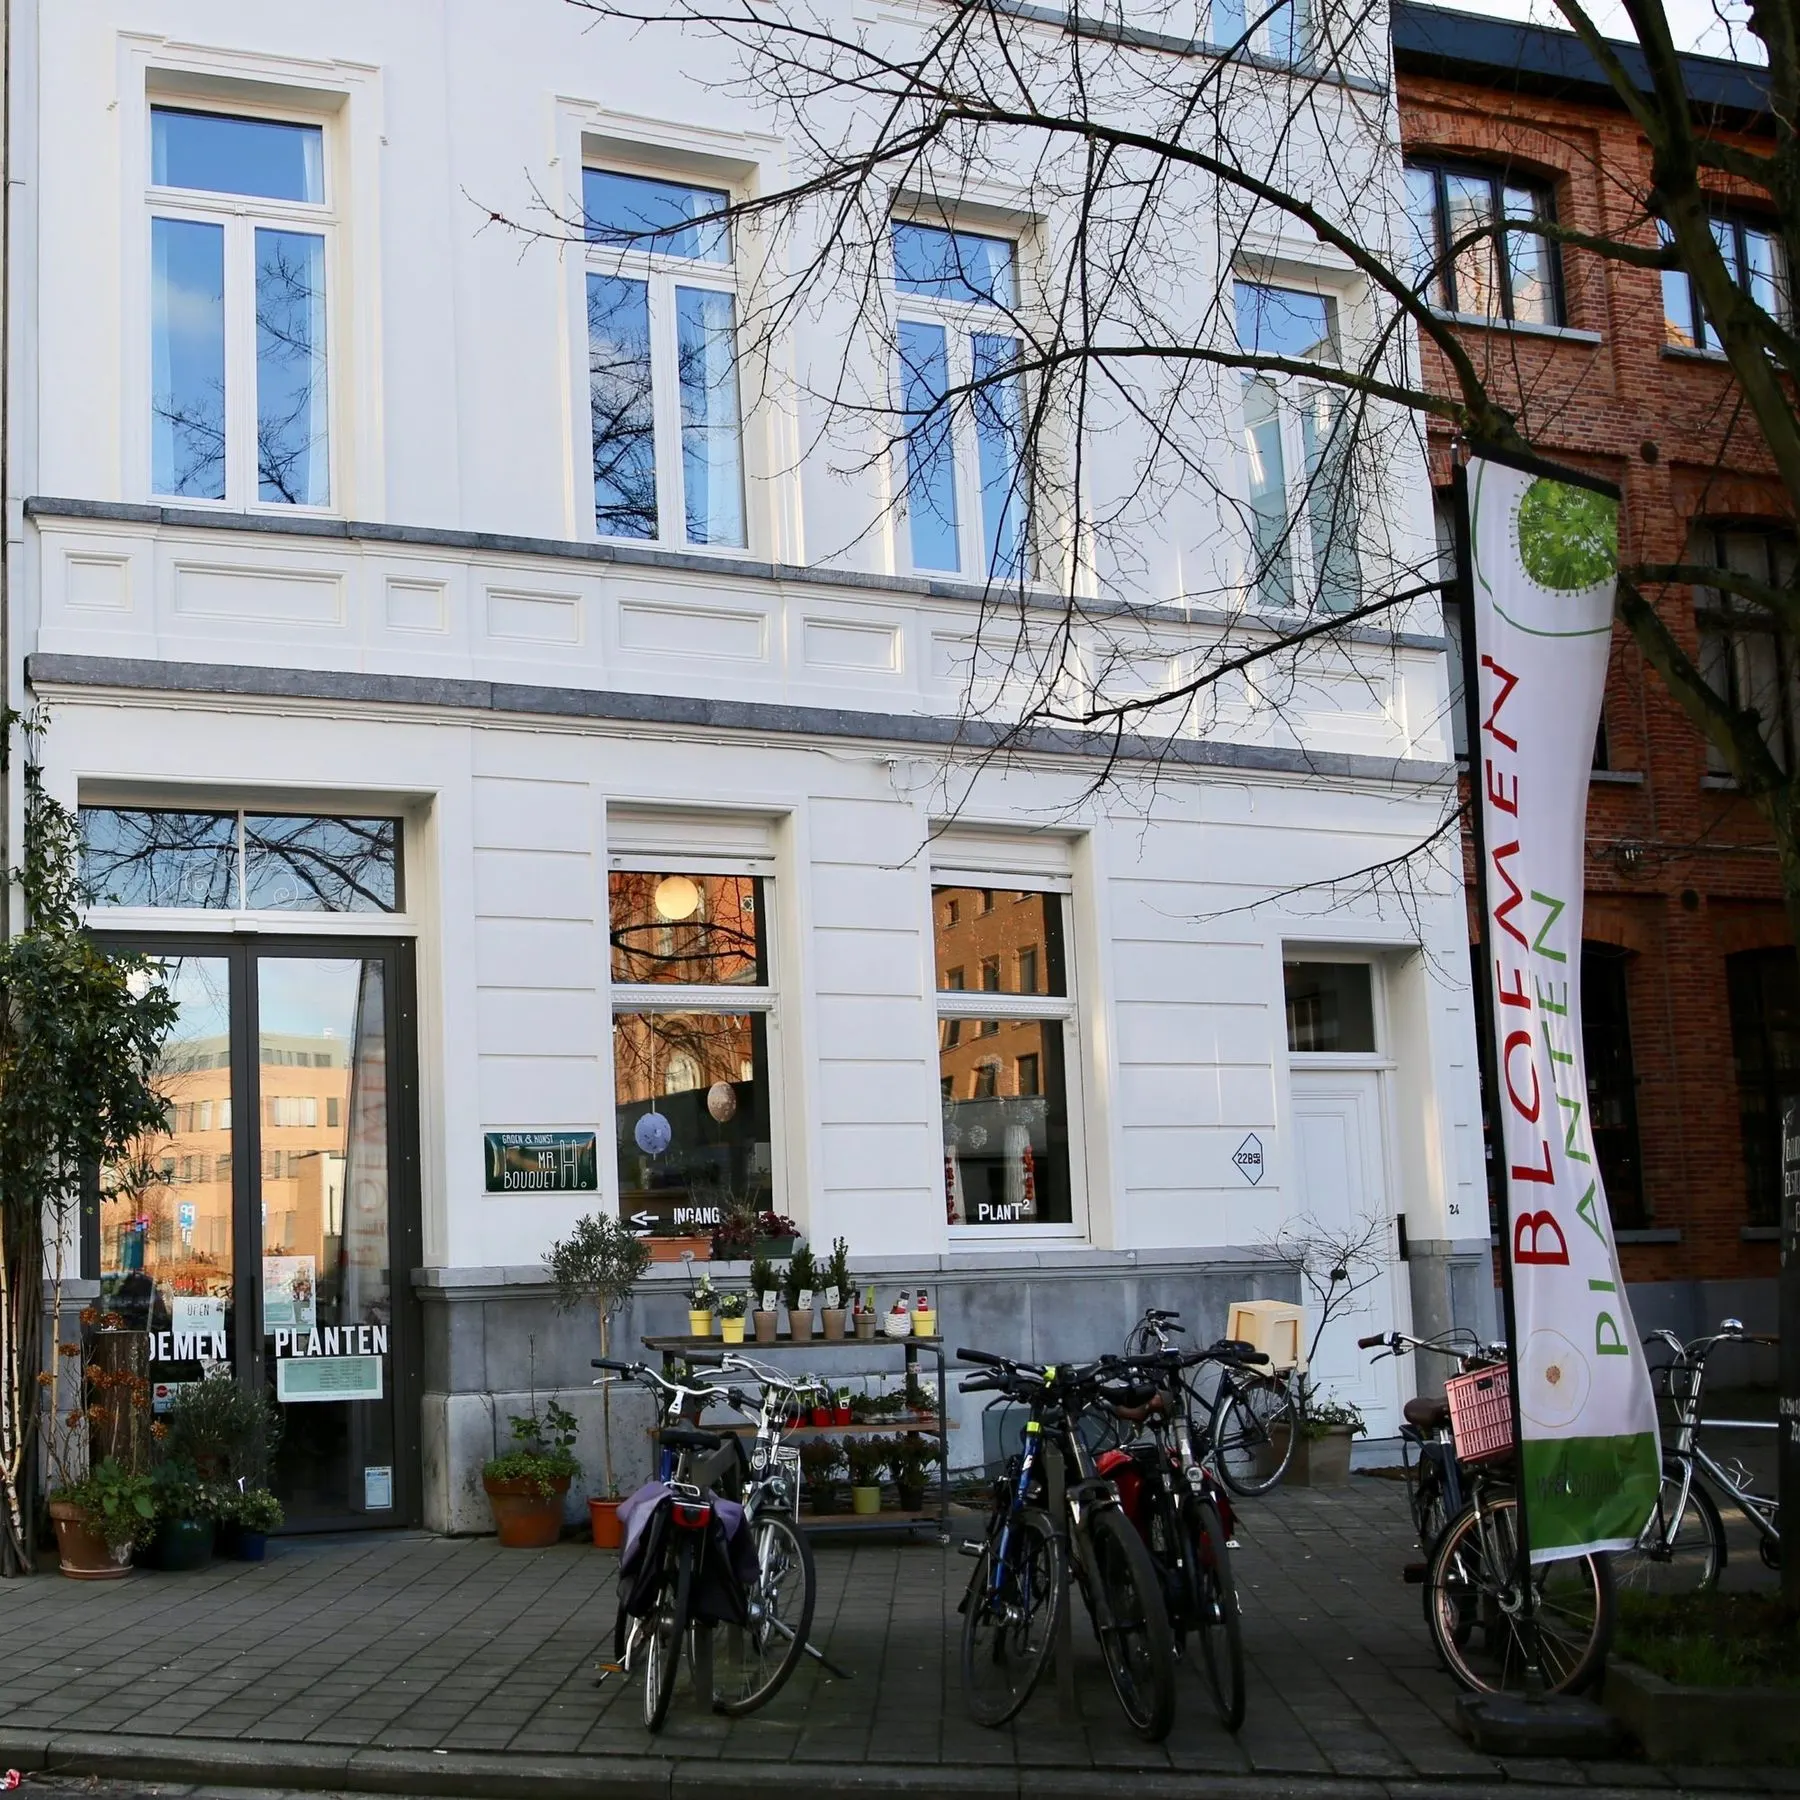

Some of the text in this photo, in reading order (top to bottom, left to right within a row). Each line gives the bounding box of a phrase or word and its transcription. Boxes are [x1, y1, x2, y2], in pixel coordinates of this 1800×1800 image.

[1481, 653, 1569, 1266] BLOEMEN
[525, 1134, 533, 1144] &
[538, 1151, 557, 1169] MR.
[503, 1170, 557, 1189] BOUQUET
[673, 1206, 721, 1225] INGANG
[187, 1303, 210, 1317] OPEN
[275, 1325, 388, 1357] PLANTEN
